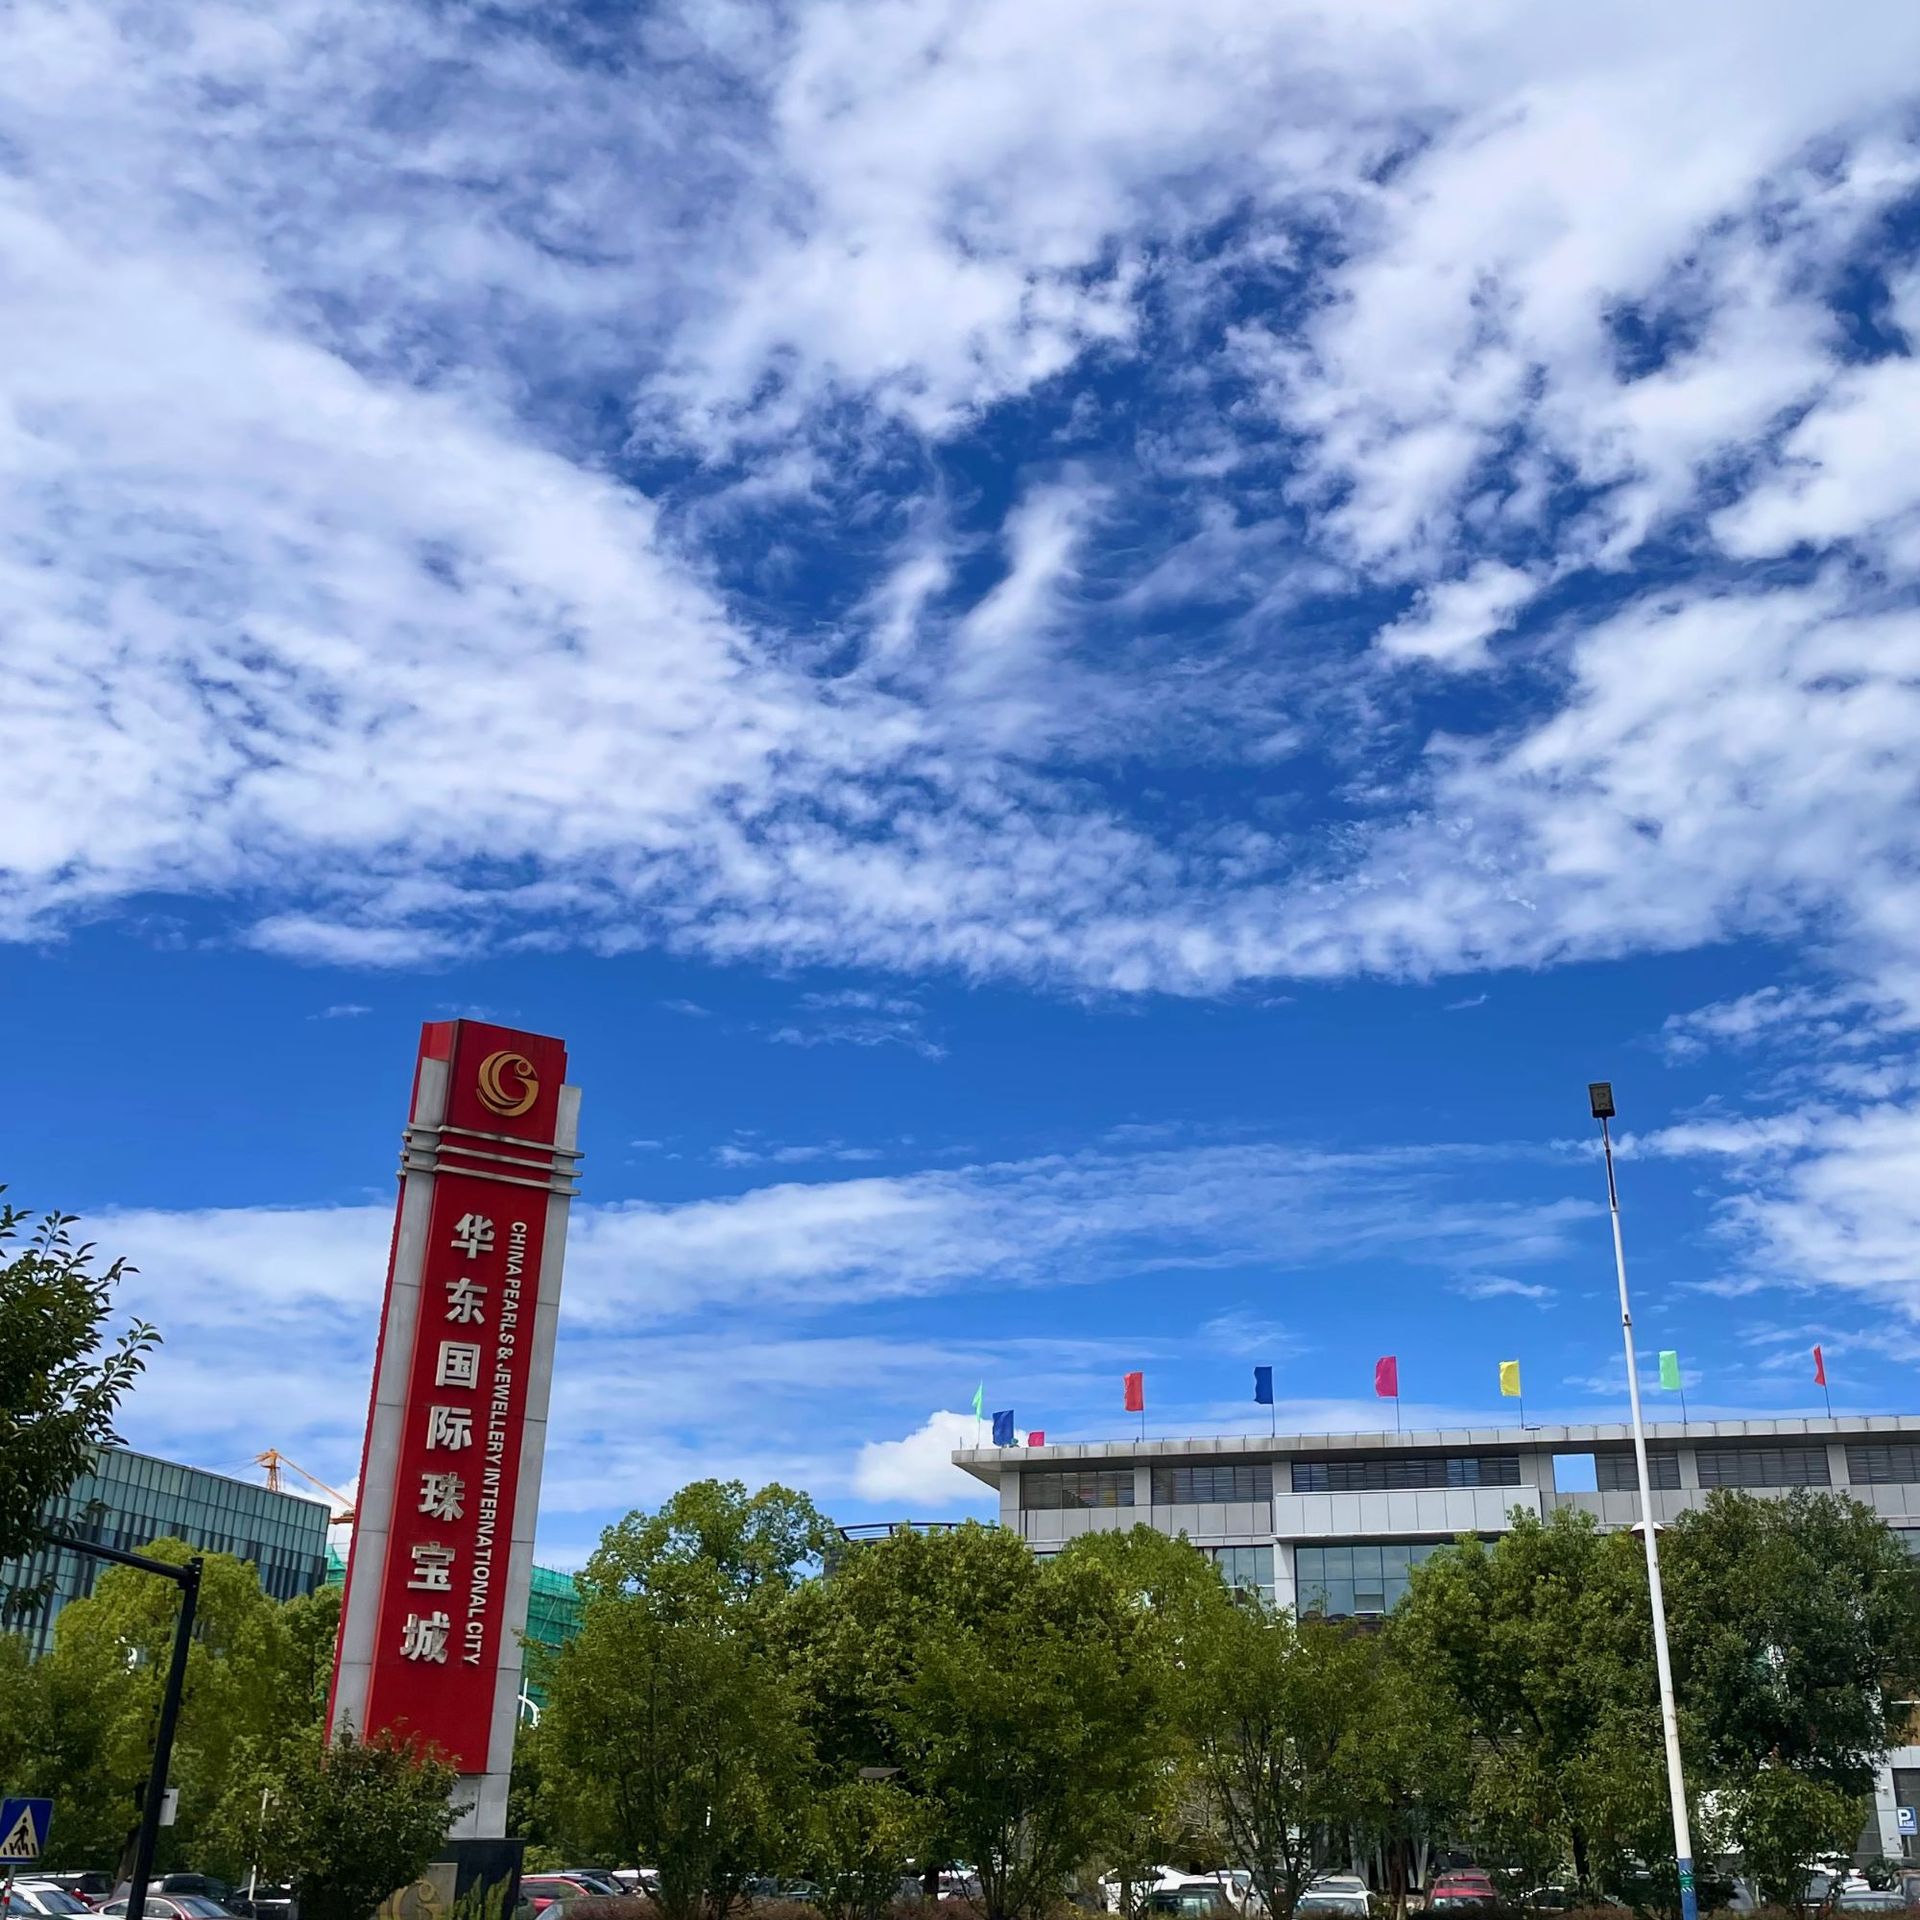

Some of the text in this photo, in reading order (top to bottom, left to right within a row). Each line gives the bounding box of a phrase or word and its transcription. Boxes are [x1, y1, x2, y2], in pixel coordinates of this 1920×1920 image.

[400, 1212, 494, 1664] 华东国际珠宝城
[463, 1221, 527, 1665] CHINA PEARLS & JEWELLERY INTERNATIONAL CITY
[1897, 1809, 1911, 1827] P
